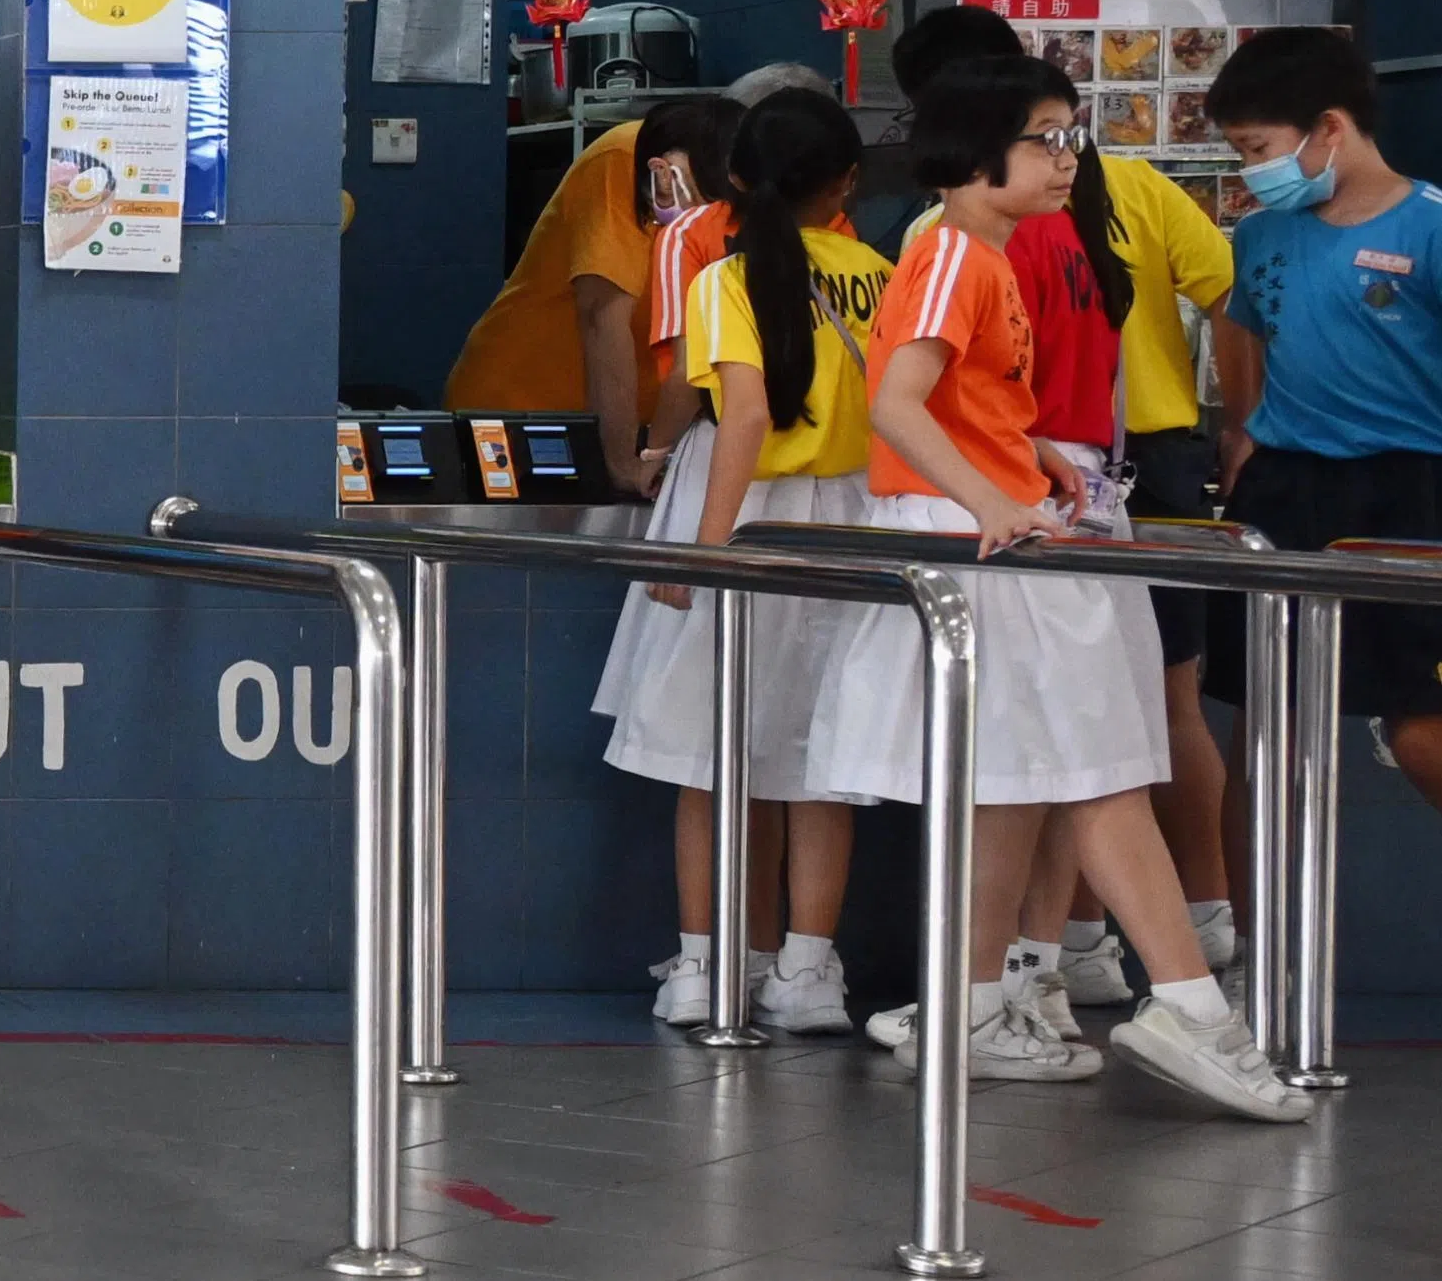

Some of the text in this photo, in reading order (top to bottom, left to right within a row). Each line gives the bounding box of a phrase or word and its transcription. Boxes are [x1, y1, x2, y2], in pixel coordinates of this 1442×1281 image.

[63, 90, 158, 103] Skip the Queue!
[100, 141, 108, 150] 2
[116, 202, 164, 214] Collection
